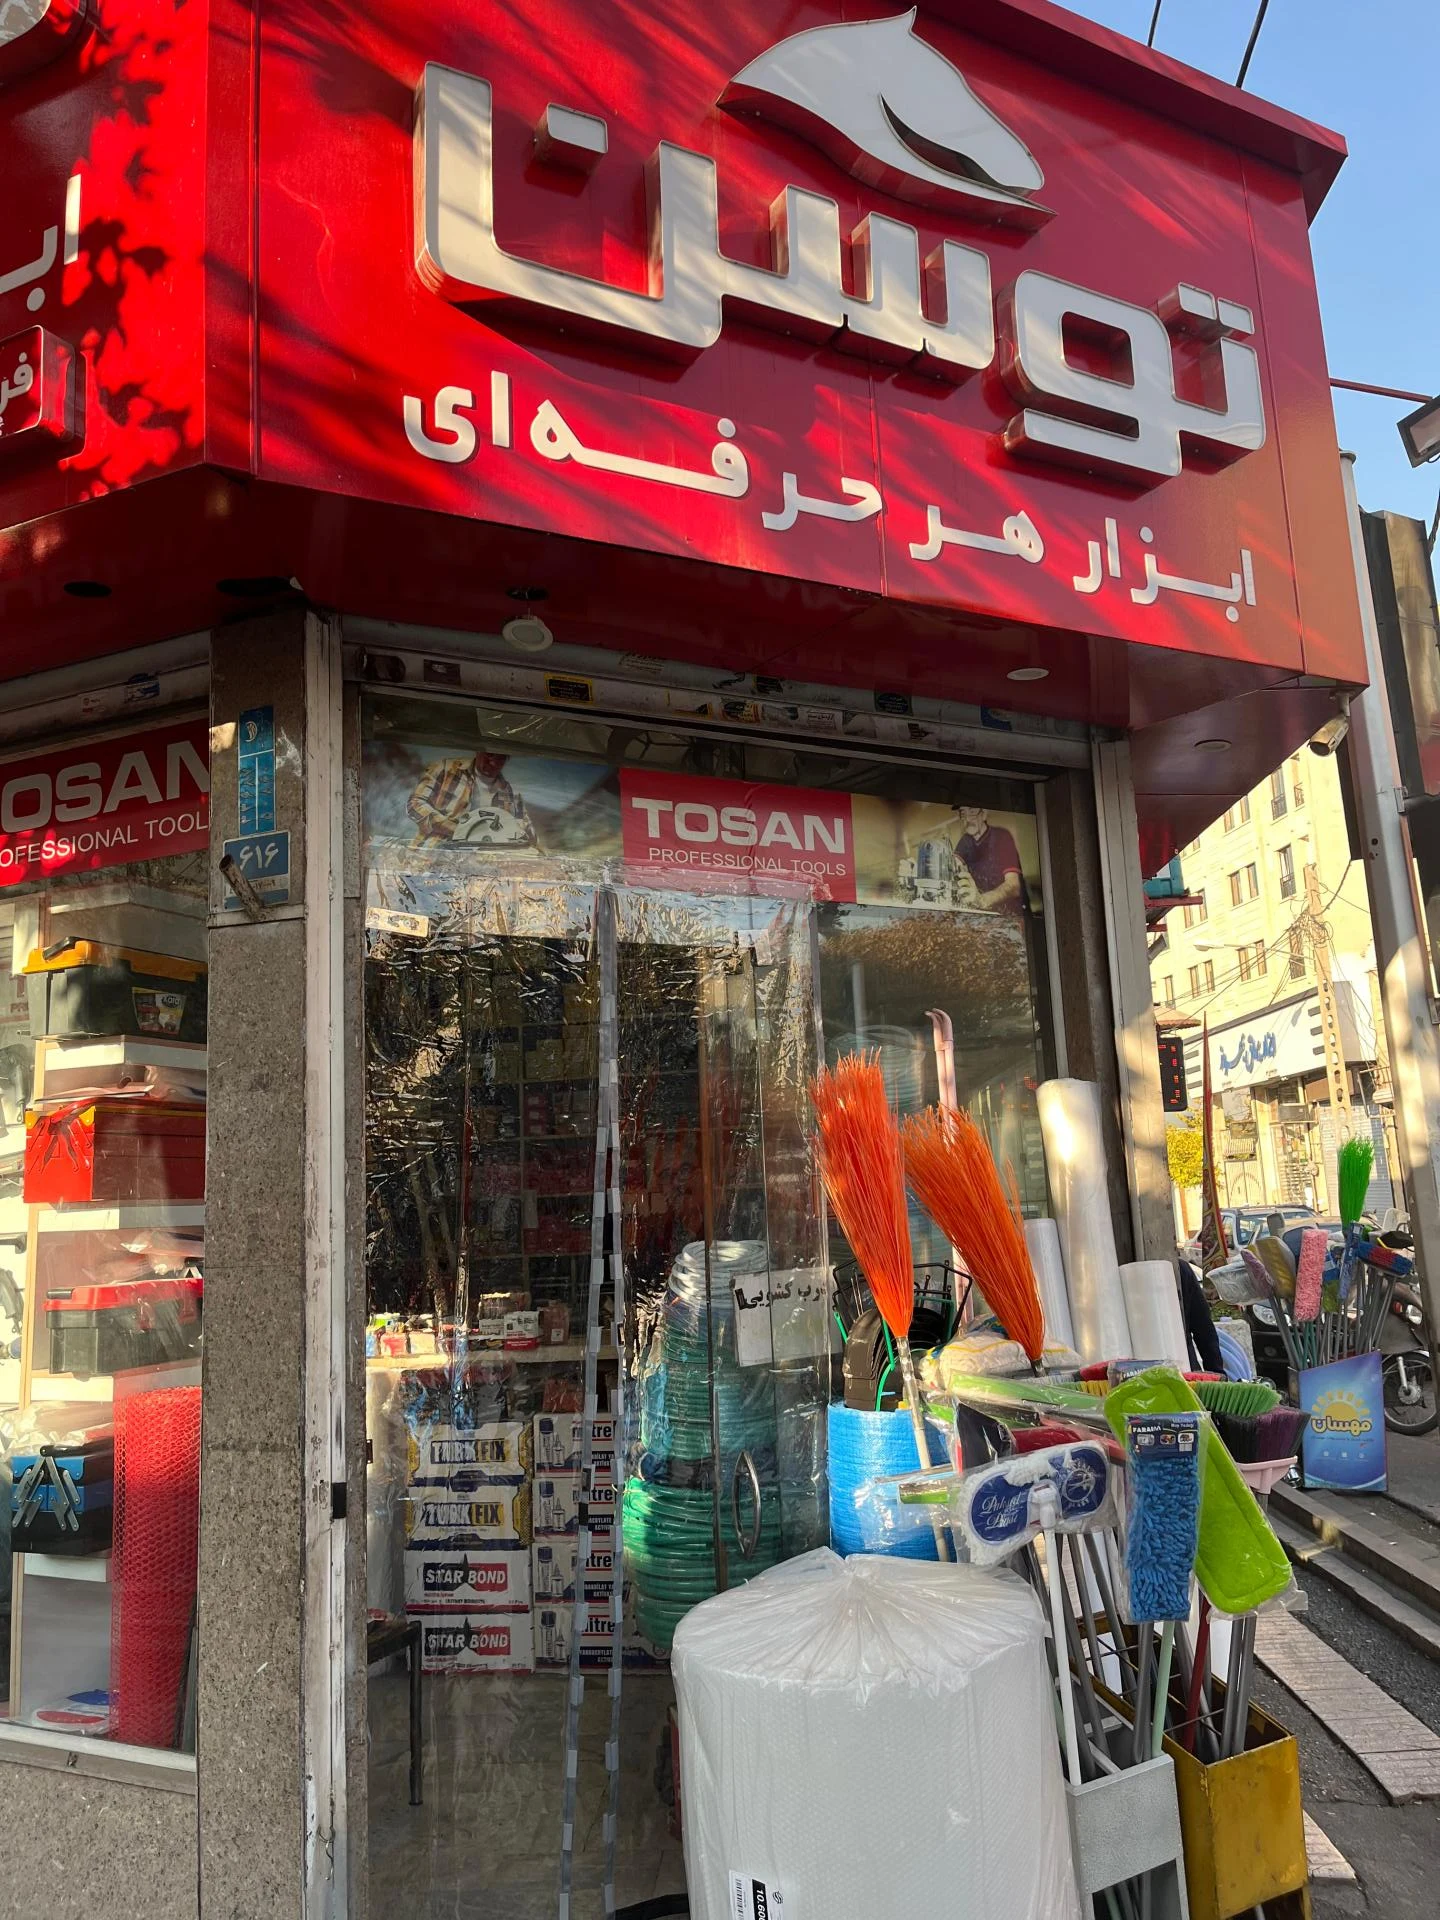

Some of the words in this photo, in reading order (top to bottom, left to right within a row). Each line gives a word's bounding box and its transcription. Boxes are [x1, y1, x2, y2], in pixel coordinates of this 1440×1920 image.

[415, 61, 1266, 477] توسن
[909, 504, 1045, 563] هر
[1072, 517, 1257, 622] ابزار
[631, 796, 846, 854] TOSAN
[648, 847, 786, 870] PROFESSIONAL
[790, 859, 846, 876] TOOLS
[1311, 1416, 1372, 1436] مهسان
[425, 1570, 464, 1584] STAR
[468, 1570, 506, 1584] BOND
[428, 1634, 465, 1649] STAR
[470, 1634, 508, 1648] BOND
